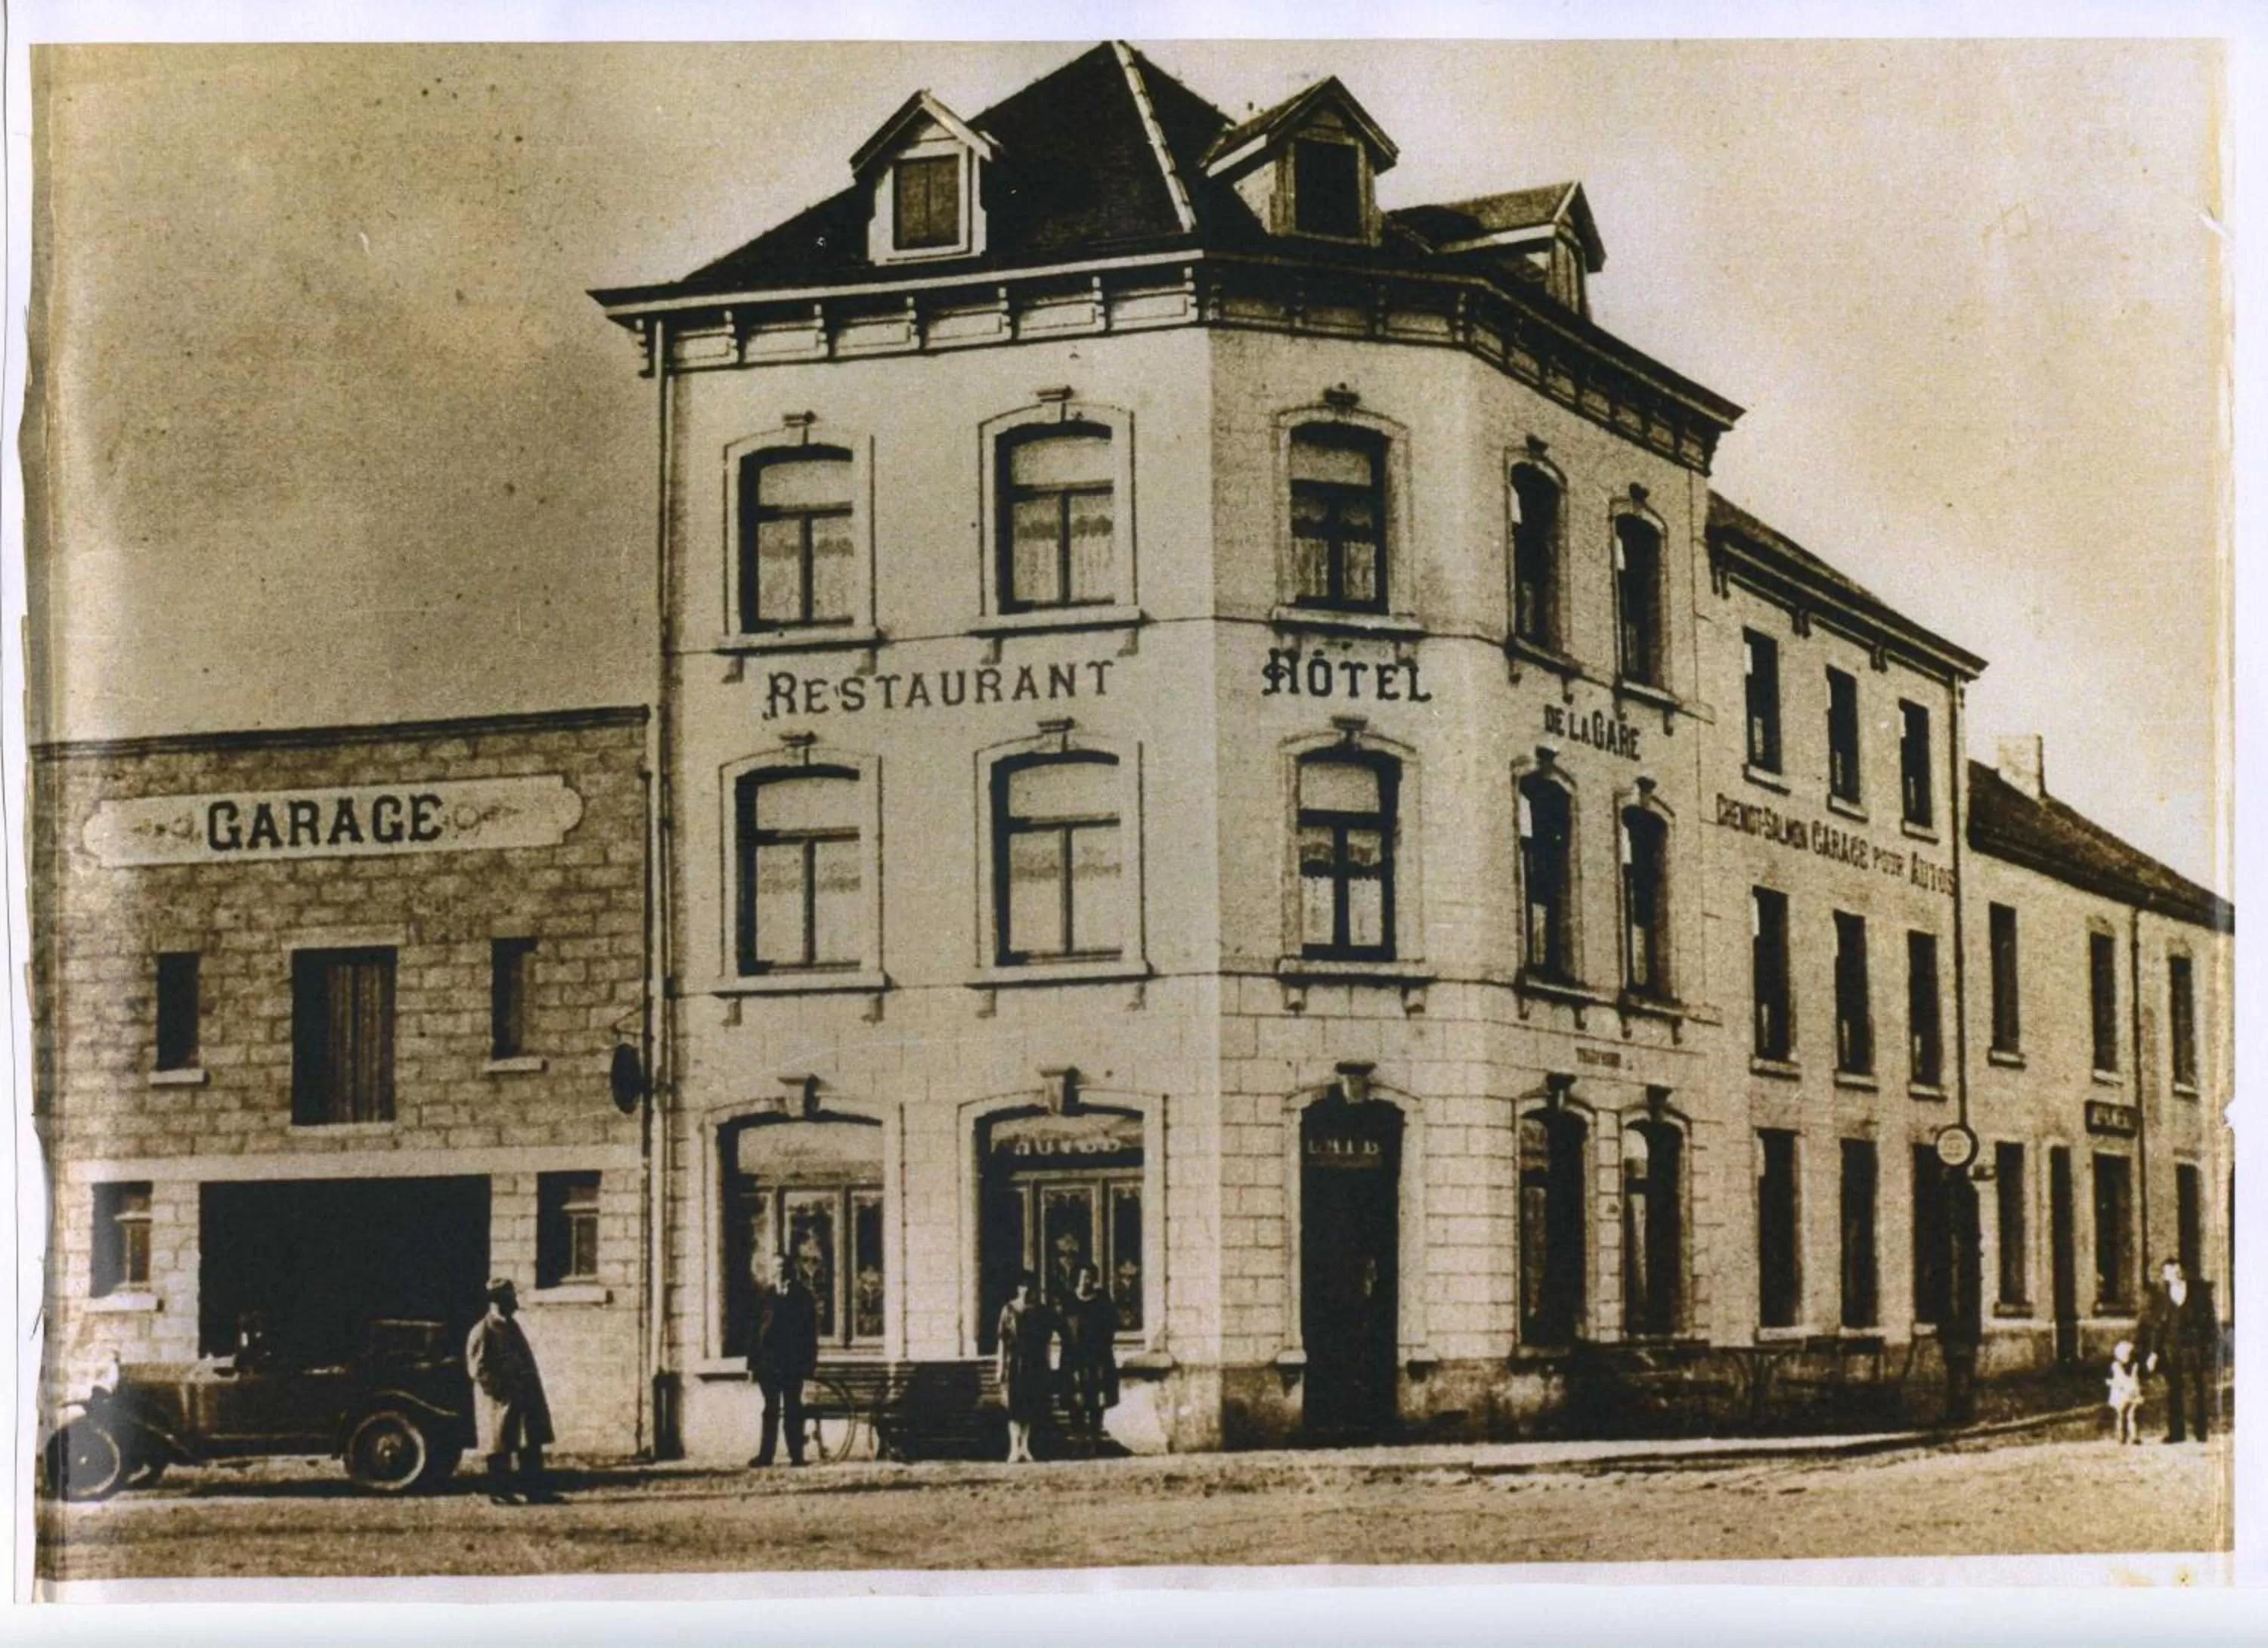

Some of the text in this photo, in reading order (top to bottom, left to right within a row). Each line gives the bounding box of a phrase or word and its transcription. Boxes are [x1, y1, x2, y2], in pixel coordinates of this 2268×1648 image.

[762, 659, 1114, 720] RESTAURANT
[1544, 703, 1566, 737] DE
[1569, 712, 1591, 745] LA
[1592, 709, 1641, 762] GARE
[207, 794, 445, 851] GARAGE
[1811, 819, 1870, 871] GARAGE
